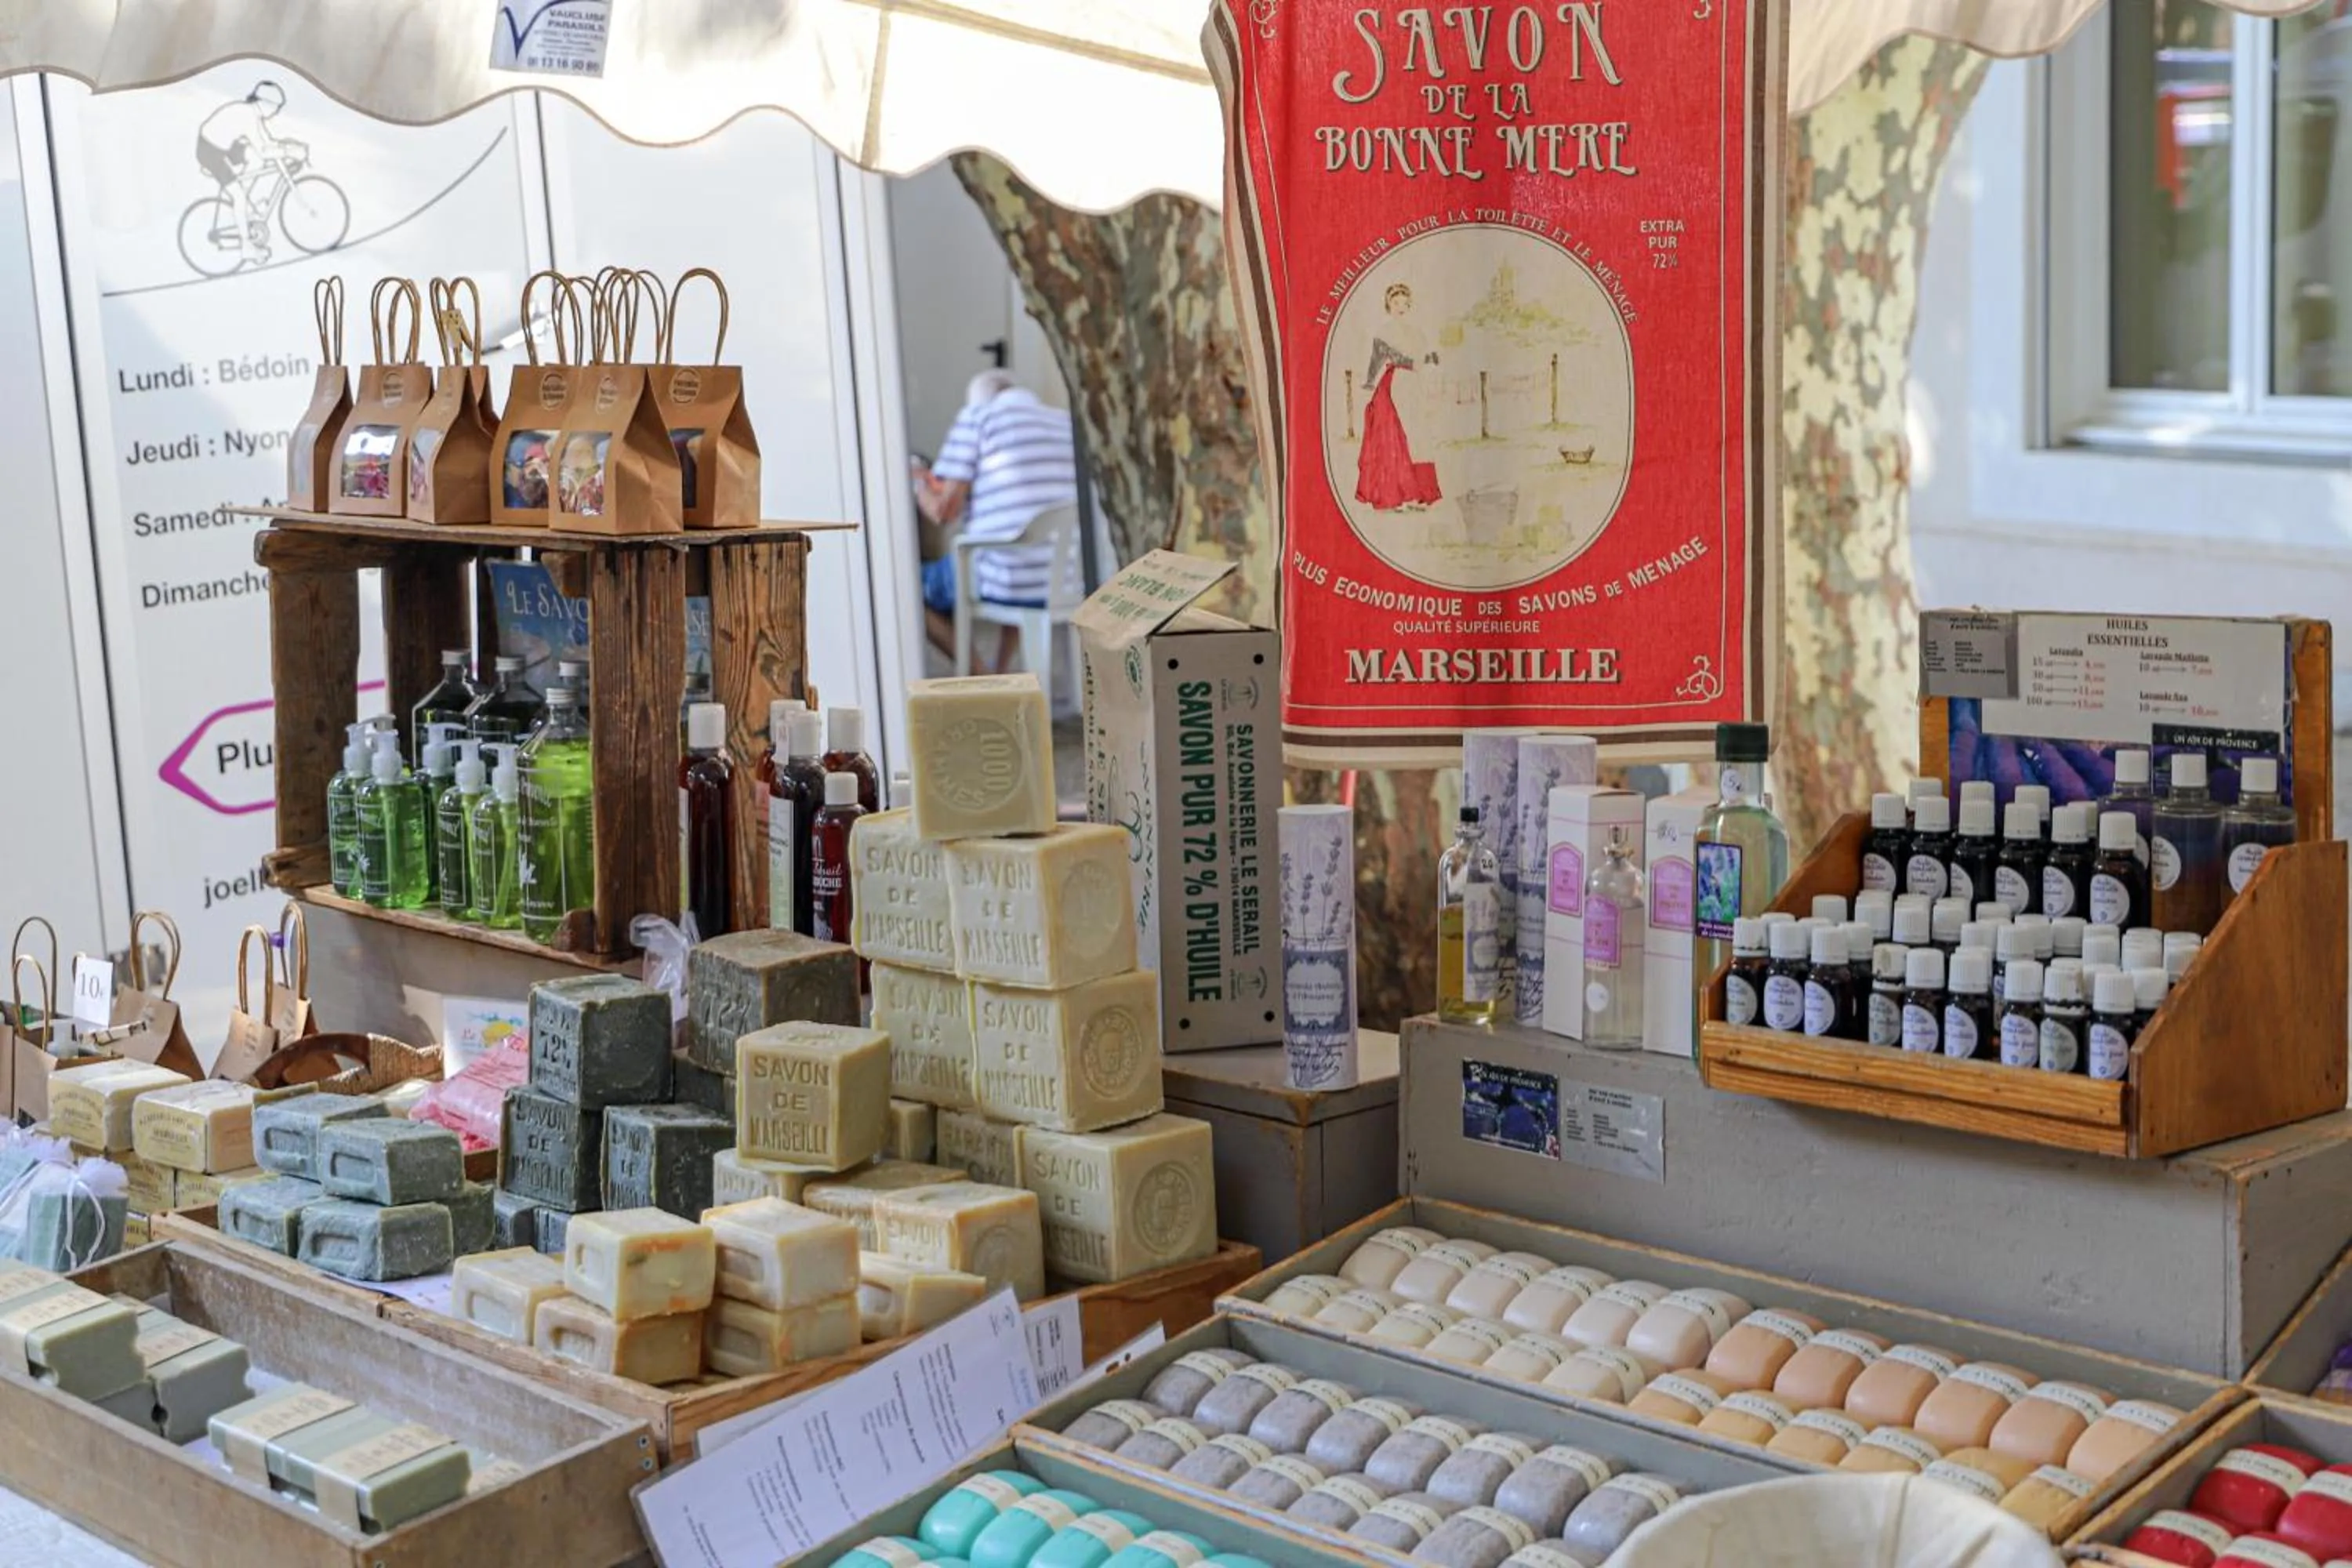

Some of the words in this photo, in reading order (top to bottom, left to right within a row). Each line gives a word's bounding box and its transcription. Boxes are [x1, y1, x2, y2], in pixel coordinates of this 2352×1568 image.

[548, 20, 605, 32] PARASOLS
[1332, 2, 1621, 103] SAVON
[1421, 84, 1475, 120] DE
[1485, 83, 1531, 119] LA
[1316, 126, 1484, 180] BONNE
[1497, 122, 1639, 176] MERE
[1640, 220, 1685, 233] EXTRA
[1649, 236, 1678, 249] PUR
[1317, 304, 1333, 325] LE
[1330, 238, 1391, 300] MEILLEUR
[1396, 216, 1440, 240] POUR
[1447, 209, 1468, 223] LA
[1551, 227, 1572, 245] ET
[1573, 241, 1593, 260] LE
[118, 364, 194, 394] Lundi
[218, 354, 310, 384] Bédoin
[126, 434, 200, 466] Jeudi
[224, 429, 289, 457] Nyon
[1292, 550, 1327, 586] PLUS
[1334, 576, 1462, 617] ECONOMIQUE
[1478, 601, 1502, 615] DES
[1518, 584, 1598, 615] SAVONS
[1604, 580, 1622, 598] DE
[1627, 535, 1709, 590] MENAGE
[506, 581, 534, 615] LE
[538, 583, 589, 623] SAVO
[2087, 633, 2169, 648] ESSENTIELLES
[2107, 618, 2148, 631] HUILES
[1344, 648, 1621, 685] MARSEILLE
[1178, 681, 1214, 767] SAVON
[216, 741, 274, 775] Plu
[980, 731, 1014, 791] 1000
[2202, 736, 2213, 746] DE
[2215, 737, 2258, 750] PROVENCE
[1181, 774, 1216, 827] PUR
[1236, 724, 1257, 848] SAVONNERIE
[866, 846, 940, 880] SAVON
[1183, 832, 1218, 864] 72
[1241, 855, 1258, 878] LE
[203, 866, 270, 910] joell
[887, 887, 916, 906] DE
[1183, 869, 1219, 896] %
[866, 911, 945, 953] MARSEILLE
[1242, 885, 1260, 955] SERAIL
[1186, 902, 1222, 1003] D'HUILE
[889, 982, 963, 1020] SAVON
[983, 1001, 1049, 1035] SAVON
[753, 1054, 829, 1087] SAVON
[1004, 1042, 1030, 1062] DE
[775, 1091, 808, 1112] DE
[984, 1069, 1057, 1112] MARSEILLE
[528, 1134, 552, 1152] DE
[1033, 1149, 1101, 1192] SAVON
[1054, 1194, 1081, 1216] DE
